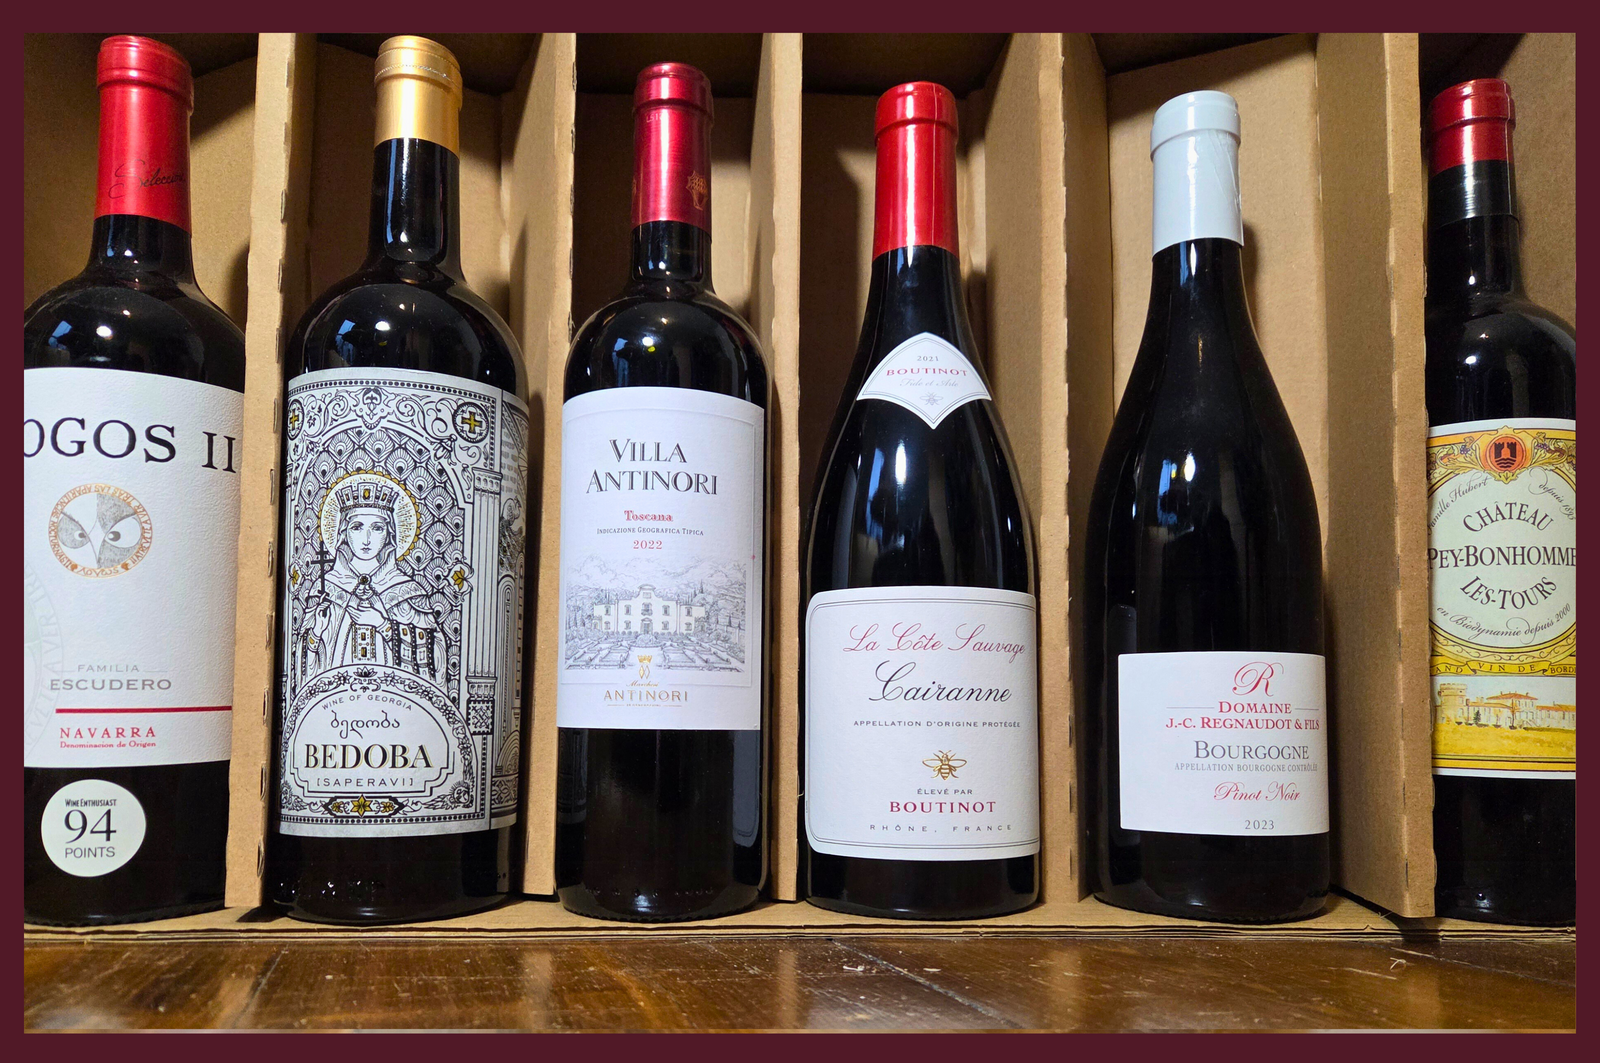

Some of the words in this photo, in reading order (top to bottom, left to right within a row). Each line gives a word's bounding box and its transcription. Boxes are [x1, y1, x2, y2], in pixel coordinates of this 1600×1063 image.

[886, 368, 968, 377] BOUTINOT
[201, 431, 237, 474] II
[609, 438, 687, 463] VILLA
[586, 469, 718, 495] ANTINORI
[1449, 471, 1493, 503] Hubert
[1528, 466, 1564, 503] depuis
[624, 510, 674, 522] Toscana
[1463, 500, 1554, 532] CHÂTEAU
[597, 527, 636, 535] INDICAZIONE
[637, 526, 681, 535] GEOGRAFICA
[682, 528, 704, 536] TIPICA
[633, 539, 663, 550] 2022
[1460, 575, 1557, 610] LES-TOURS
[1436, 606, 1450, 617] en
[1449, 613, 1521, 640] Biodynamie
[1505, 616, 1554, 645] depuis
[1554, 602, 1571, 623] 2000
[843, 623, 881, 652] La
[887, 621, 944, 651] Côte
[947, 622, 1026, 664] Sauvage
[77, 664, 140, 673] FAMILIA
[1478, 662, 1506, 672] VIN
[1518, 663, 1536, 672] DE
[50, 678, 172, 691] ESCUDERO
[868, 659, 1012, 702] Cairanne
[1232, 661, 1284, 697] R
[603, 689, 689, 702] ANTINORI
[321, 697, 344, 711] WINE
[349, 694, 362, 702] OF
[367, 694, 412, 711] GEORGIA
[1218, 701, 1292, 714] DOMAINE
[853, 719, 922, 727] APPELLATION
[926, 720, 979, 728] D'ORIGINE
[982, 720, 1021, 728] PROTÉGÉE
[1165, 717, 1197, 729] J.-C.
[1200, 716, 1292, 730] REGNAUDOT
[1294, 719, 1303, 730] &
[1304, 719, 1320, 731] FILS
[59, 726, 156, 739] NAVARRA
[60, 741, 114, 749] Denominacion
[129, 740, 157, 749] Origen
[1194, 740, 1310, 760] BOURGOGNE
[304, 743, 434, 769] BEDOBA
[1174, 762, 1234, 772] APPELLATION
[1237, 763, 1286, 773] BOURGOGNE
[917, 787, 949, 795] ÉLEVÉ
[1213, 781, 1262, 801] Pinot
[1265, 780, 1301, 801] Noir
[889, 801, 997, 813] BOUTINOT
[64, 808, 117, 844] 94
[869, 824, 937, 833] RHÔNE,
[952, 824, 1012, 832] FRANCE
[1244, 819, 1275, 830] 2023
[65, 846, 116, 859] POINTS
